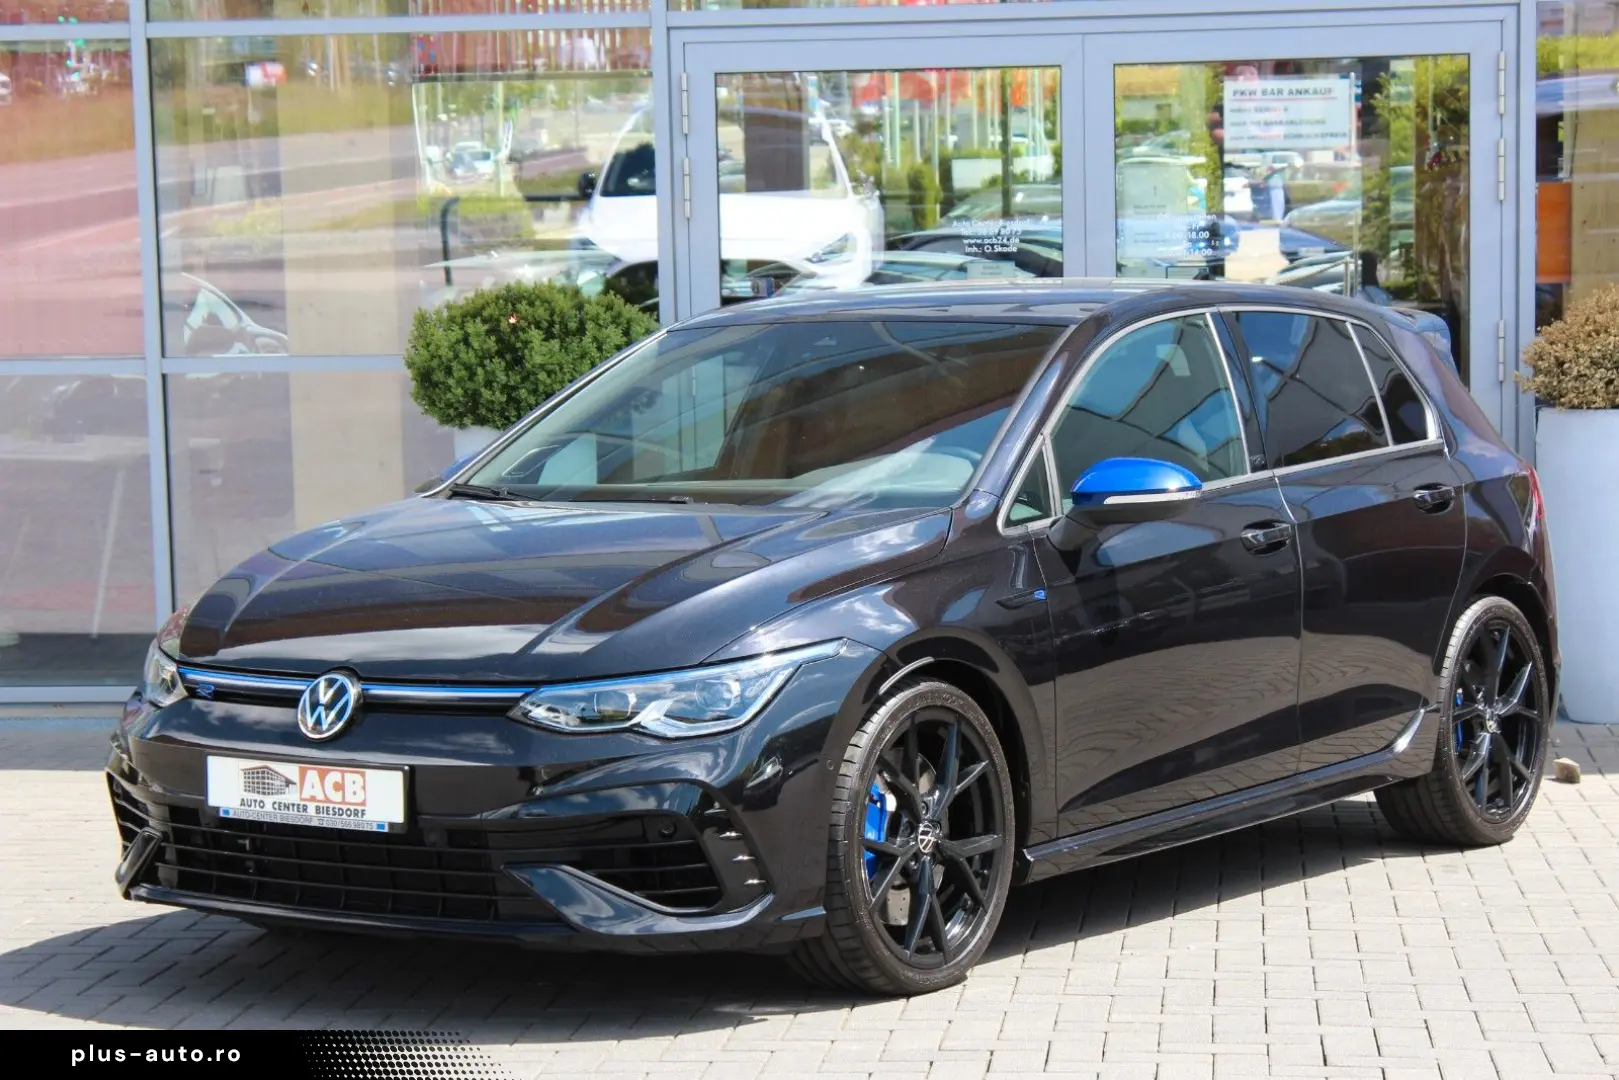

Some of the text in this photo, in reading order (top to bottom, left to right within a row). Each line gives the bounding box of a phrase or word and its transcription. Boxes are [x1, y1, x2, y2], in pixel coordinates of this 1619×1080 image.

[1287, 86, 1333, 96] ANKAUF
[963, 236, 1020, 244] www.acb24.de
[300, 768, 366, 804] ACB
[240, 797, 366, 819] AUTO CENTER BIESDORF
